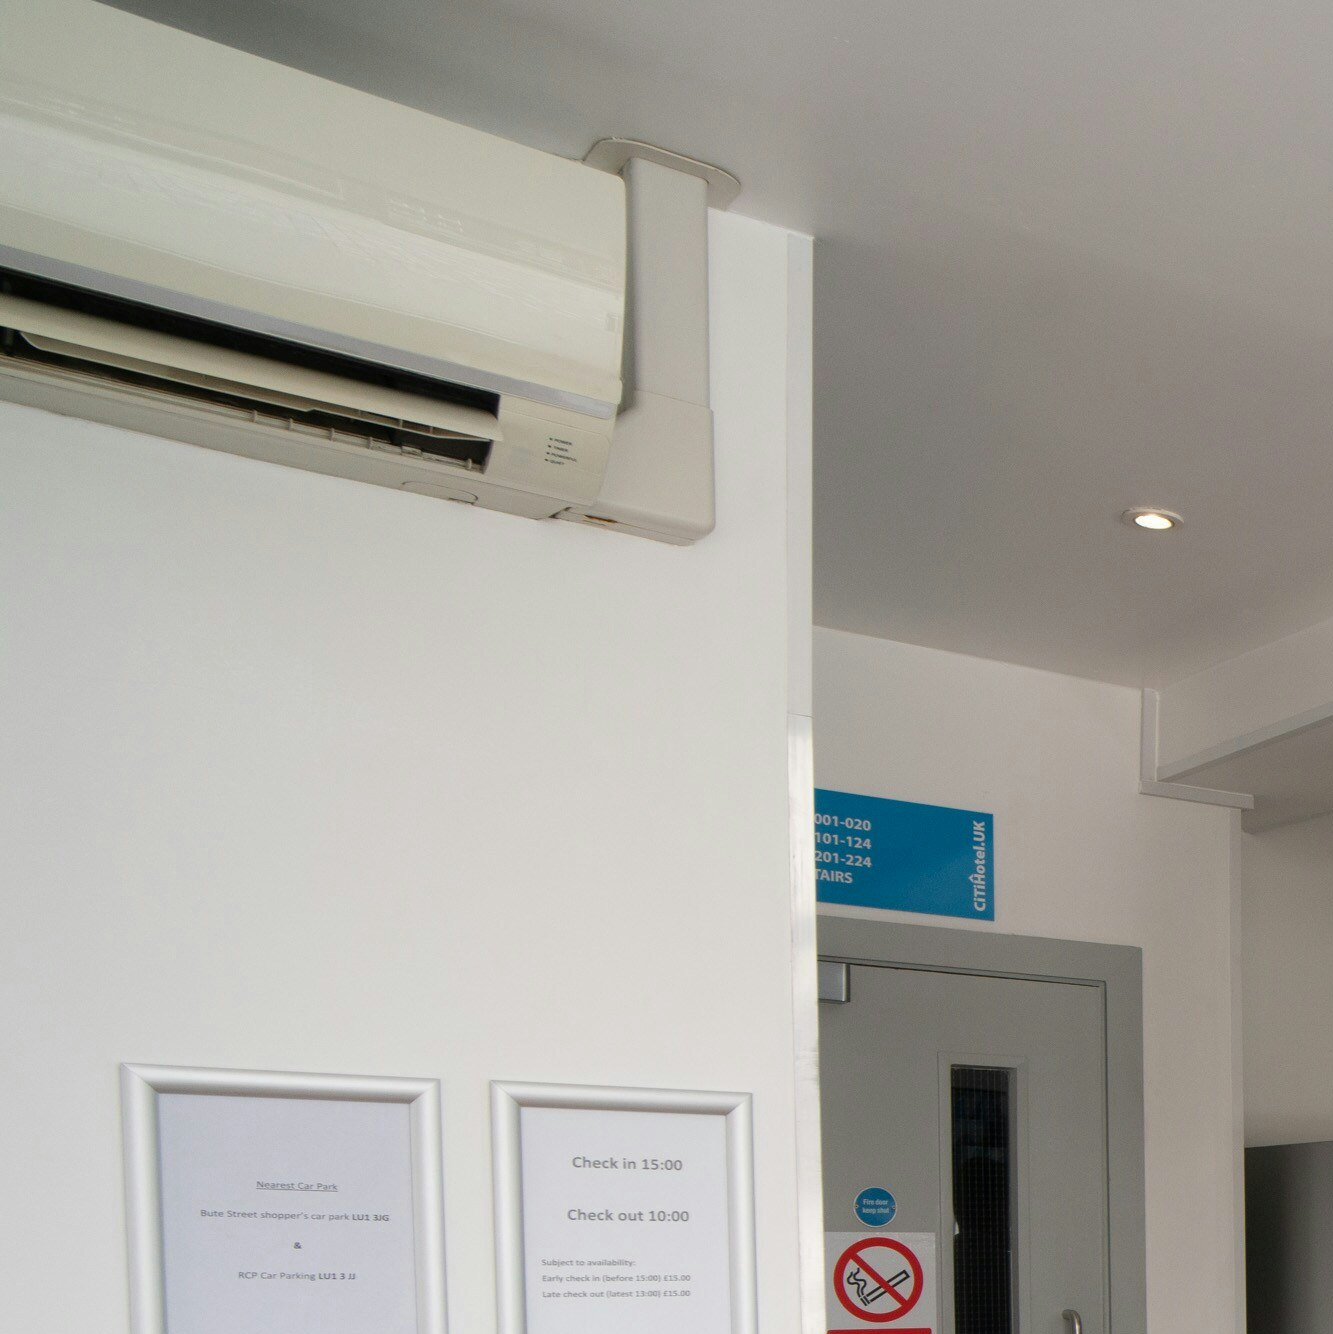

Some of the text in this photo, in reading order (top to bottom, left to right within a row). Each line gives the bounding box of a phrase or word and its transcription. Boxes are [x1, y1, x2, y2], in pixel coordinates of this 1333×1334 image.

[815, 813, 871, 831] 001-020
[815, 832, 872, 849] 101-124
[815, 851, 872, 868] 201-224
[969, 820, 986, 912] CiTiHotel.UK
[815, 868, 853, 884] TAIRS
[572, 1156, 683, 1170] Check in 15:00
[256, 1181, 338, 1191] Nearest Car Park
[200, 1209, 224, 1218] Bute
[227, 1210, 257, 1219] Street
[329, 1213, 350, 1221] park
[352, 1213, 369, 1221] LU1
[567, 1209, 689, 1221] Check out 10:00
[541, 1259, 574, 1267] Subject
[587, 1259, 636, 1267] availability:
[238, 1271, 257, 1279] RCP
[280, 1272, 316, 1281] Parking
[318, 1272, 336, 1280] LU1
[542, 1275, 563, 1283] Early
[602, 1275, 633, 1283] (before
